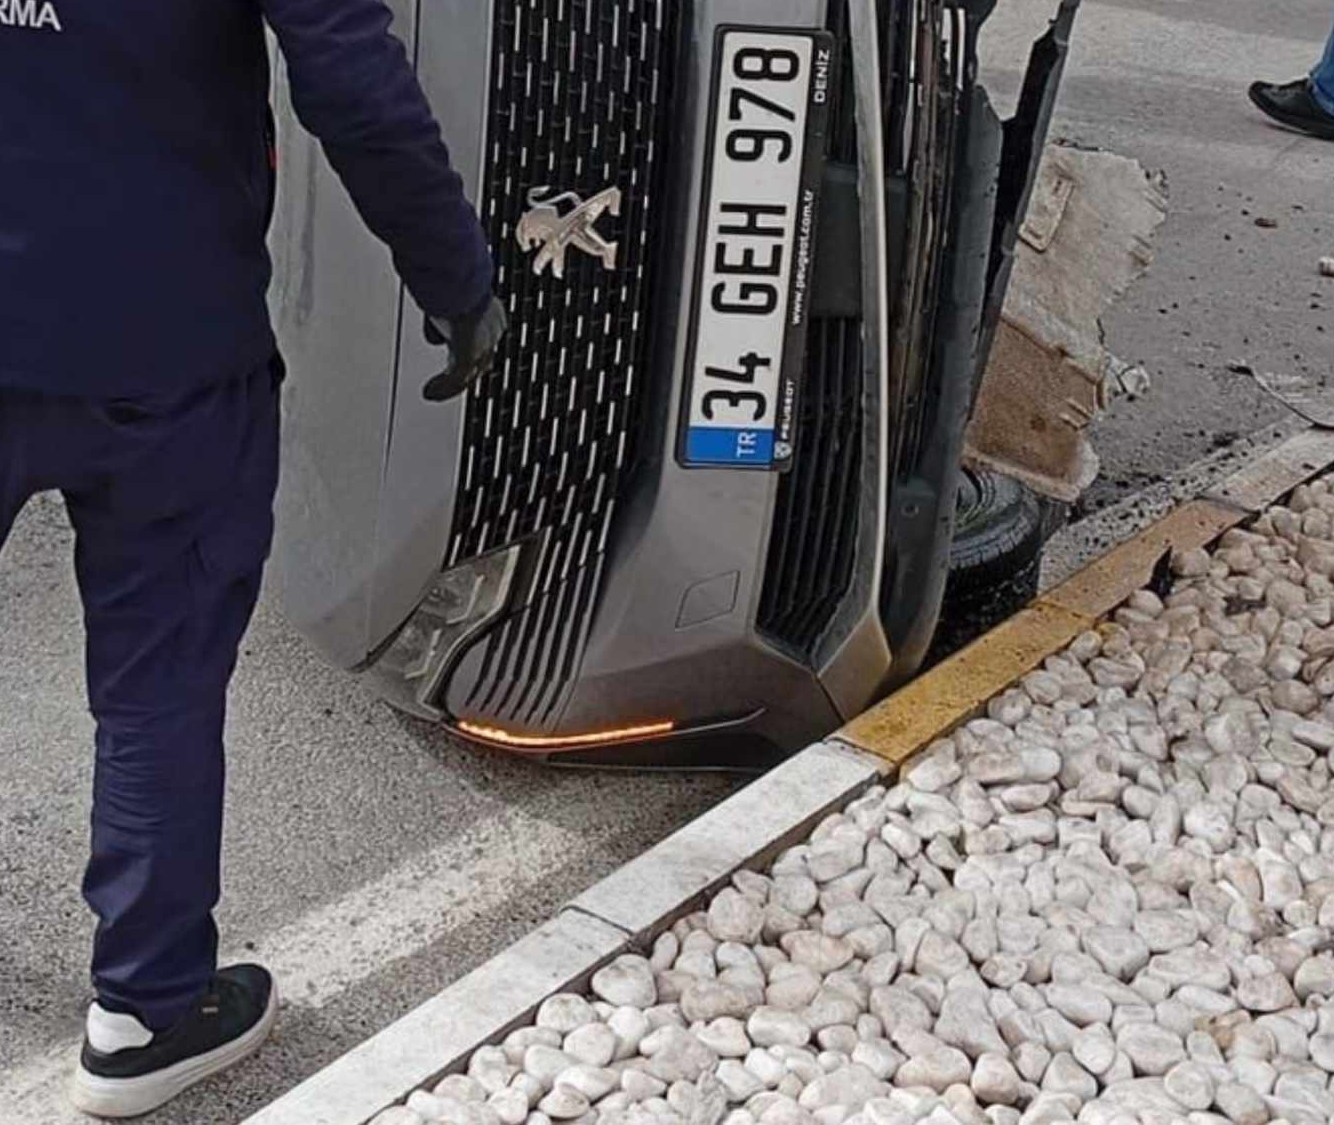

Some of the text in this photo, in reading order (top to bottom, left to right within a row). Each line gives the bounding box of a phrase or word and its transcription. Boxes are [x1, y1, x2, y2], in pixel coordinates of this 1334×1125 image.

[813, 49, 830, 104] DENİZ
[701, 47, 800, 421] 34 GEH 978
[792, 189, 814, 325] www.peugeot.com.tr
[735, 432, 758, 458] TR
